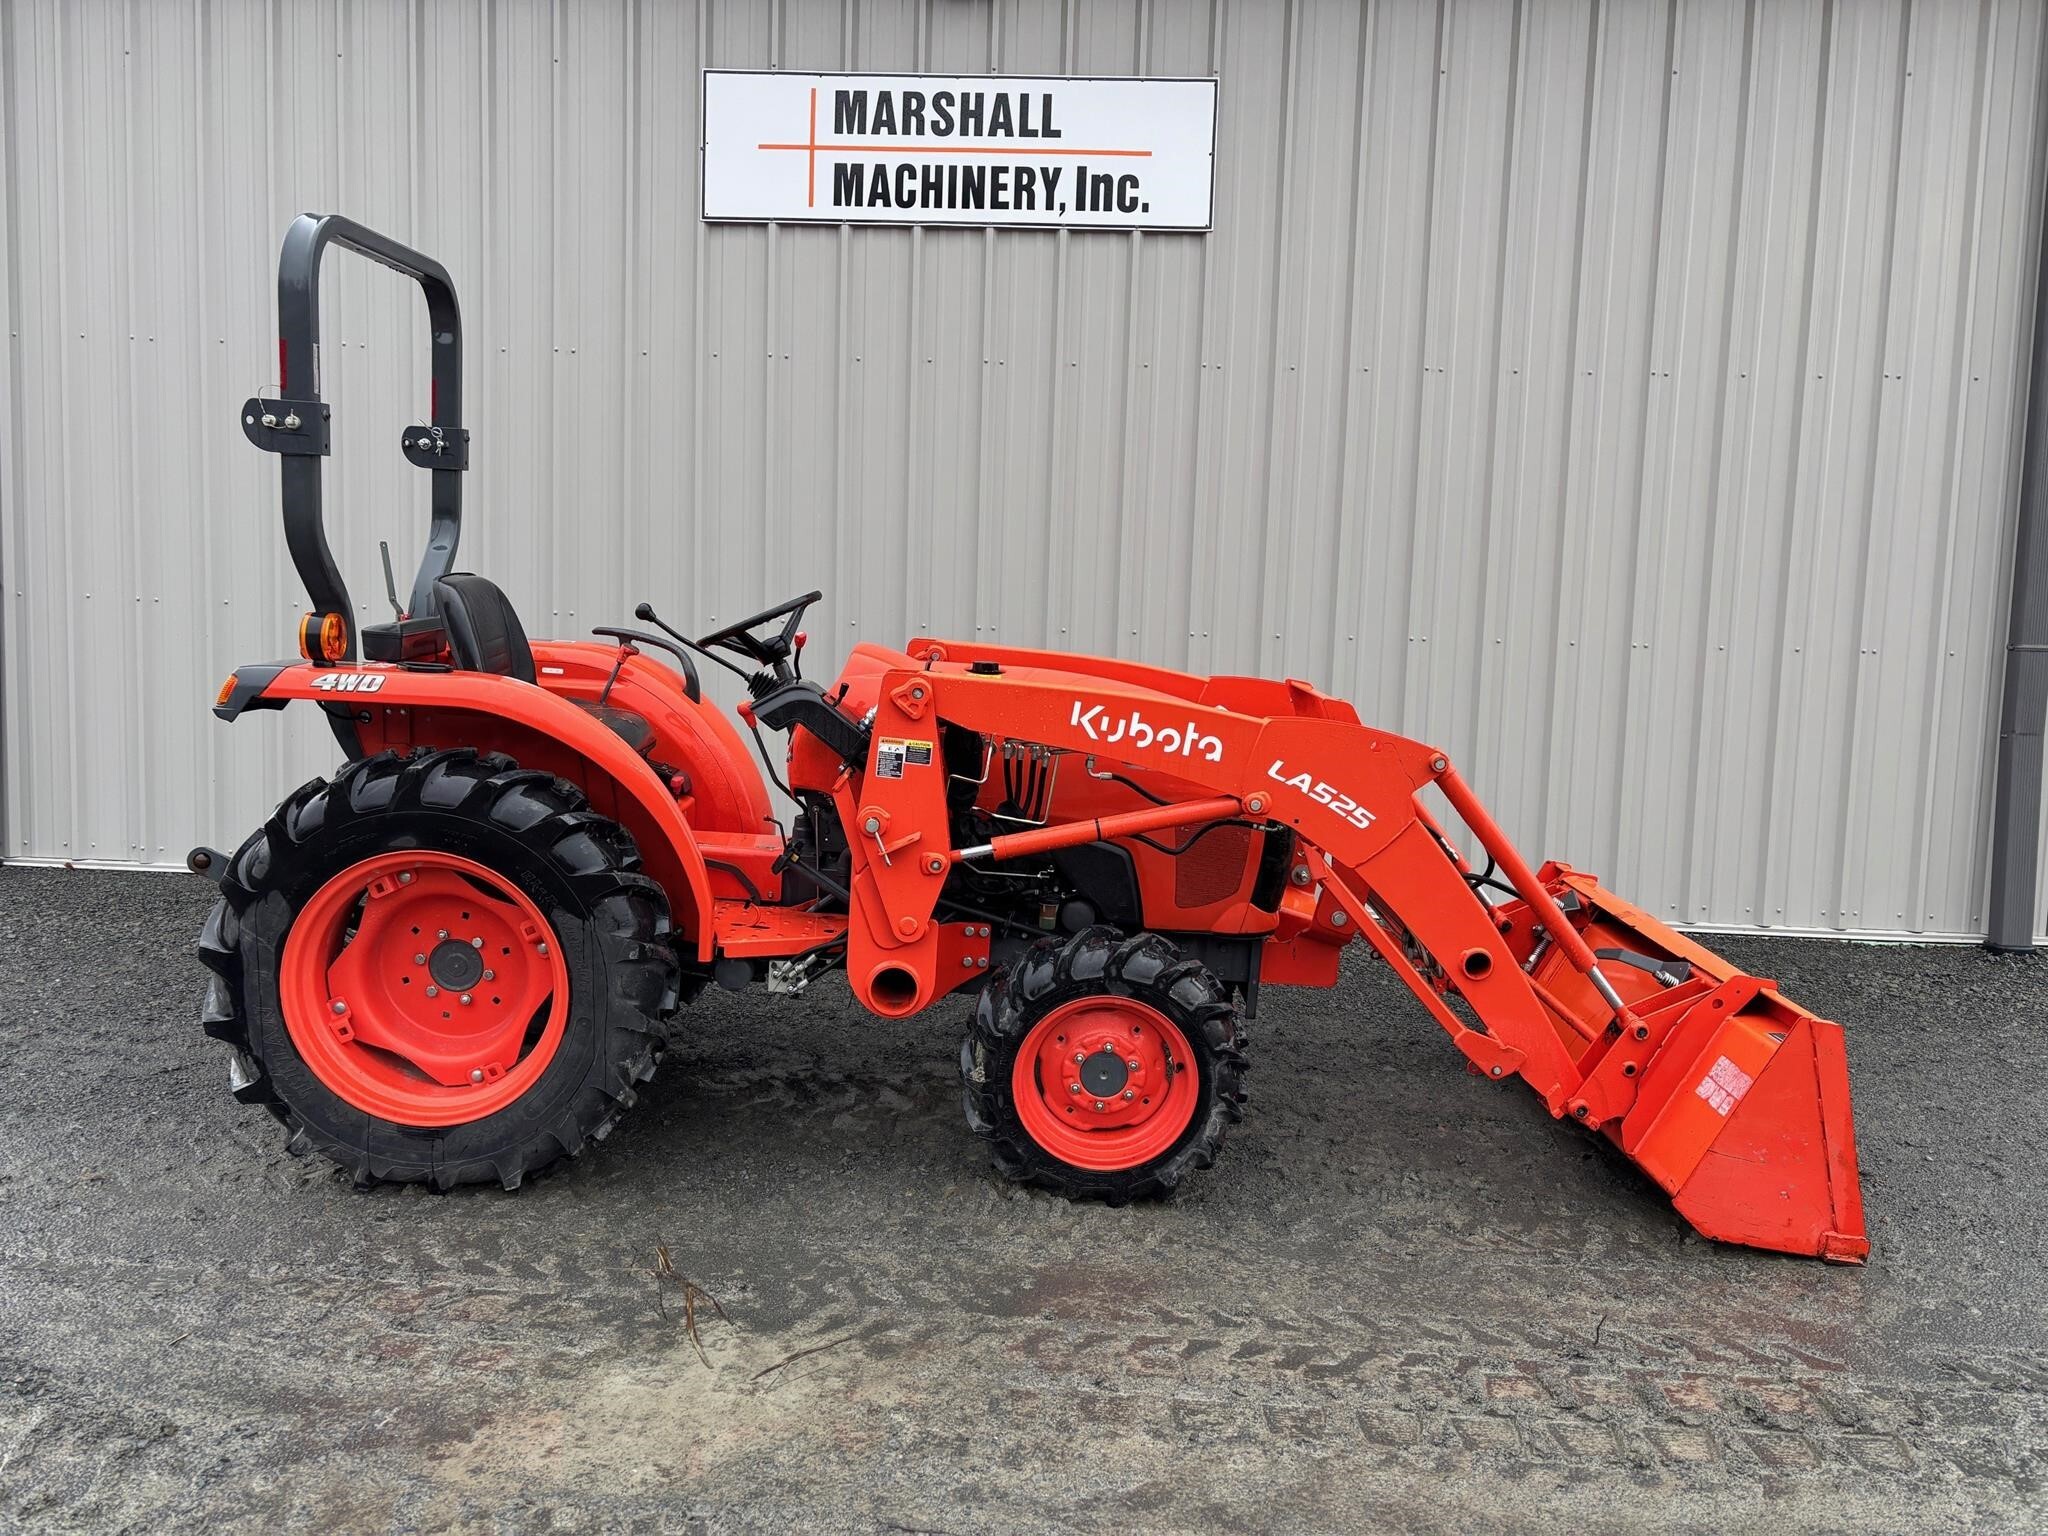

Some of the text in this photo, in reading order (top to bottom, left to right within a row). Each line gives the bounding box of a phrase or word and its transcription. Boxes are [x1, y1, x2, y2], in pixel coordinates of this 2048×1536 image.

[834, 90, 1062, 139] MARSHALL
[833, 162, 1150, 217] MACHINERY, Inc.
[310, 672, 387, 694] 4WD
[1070, 700, 1223, 762] Kubota
[1267, 759, 1377, 829] LA525
